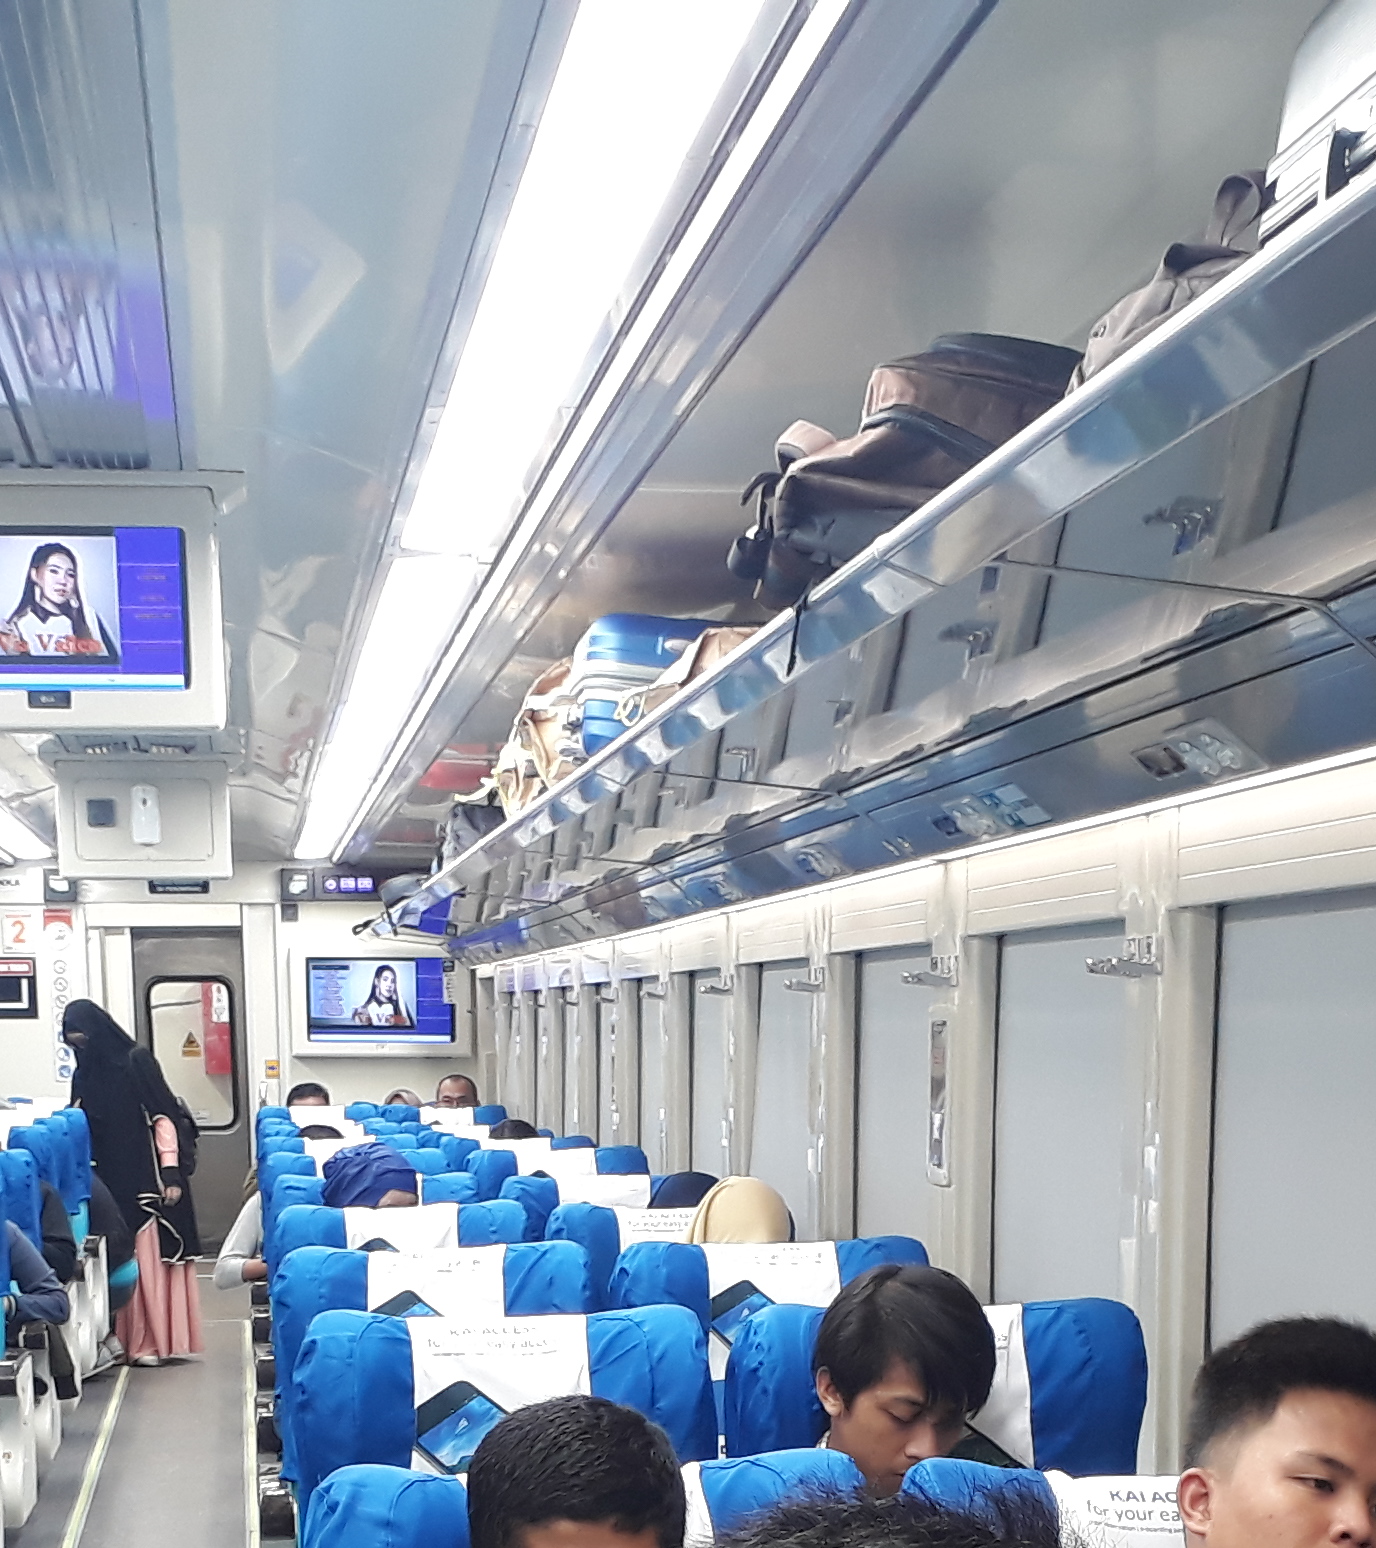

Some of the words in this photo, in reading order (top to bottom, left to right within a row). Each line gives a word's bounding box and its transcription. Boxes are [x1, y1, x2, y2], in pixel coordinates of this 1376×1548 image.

[11, 920, 26, 944] 2
[1109, 1490, 1146, 1503] KAI
[1151, 1491, 1178, 1504] AC
[1115, 1508, 1155, 1523] your
[1159, 1509, 1180, 1522] ea
